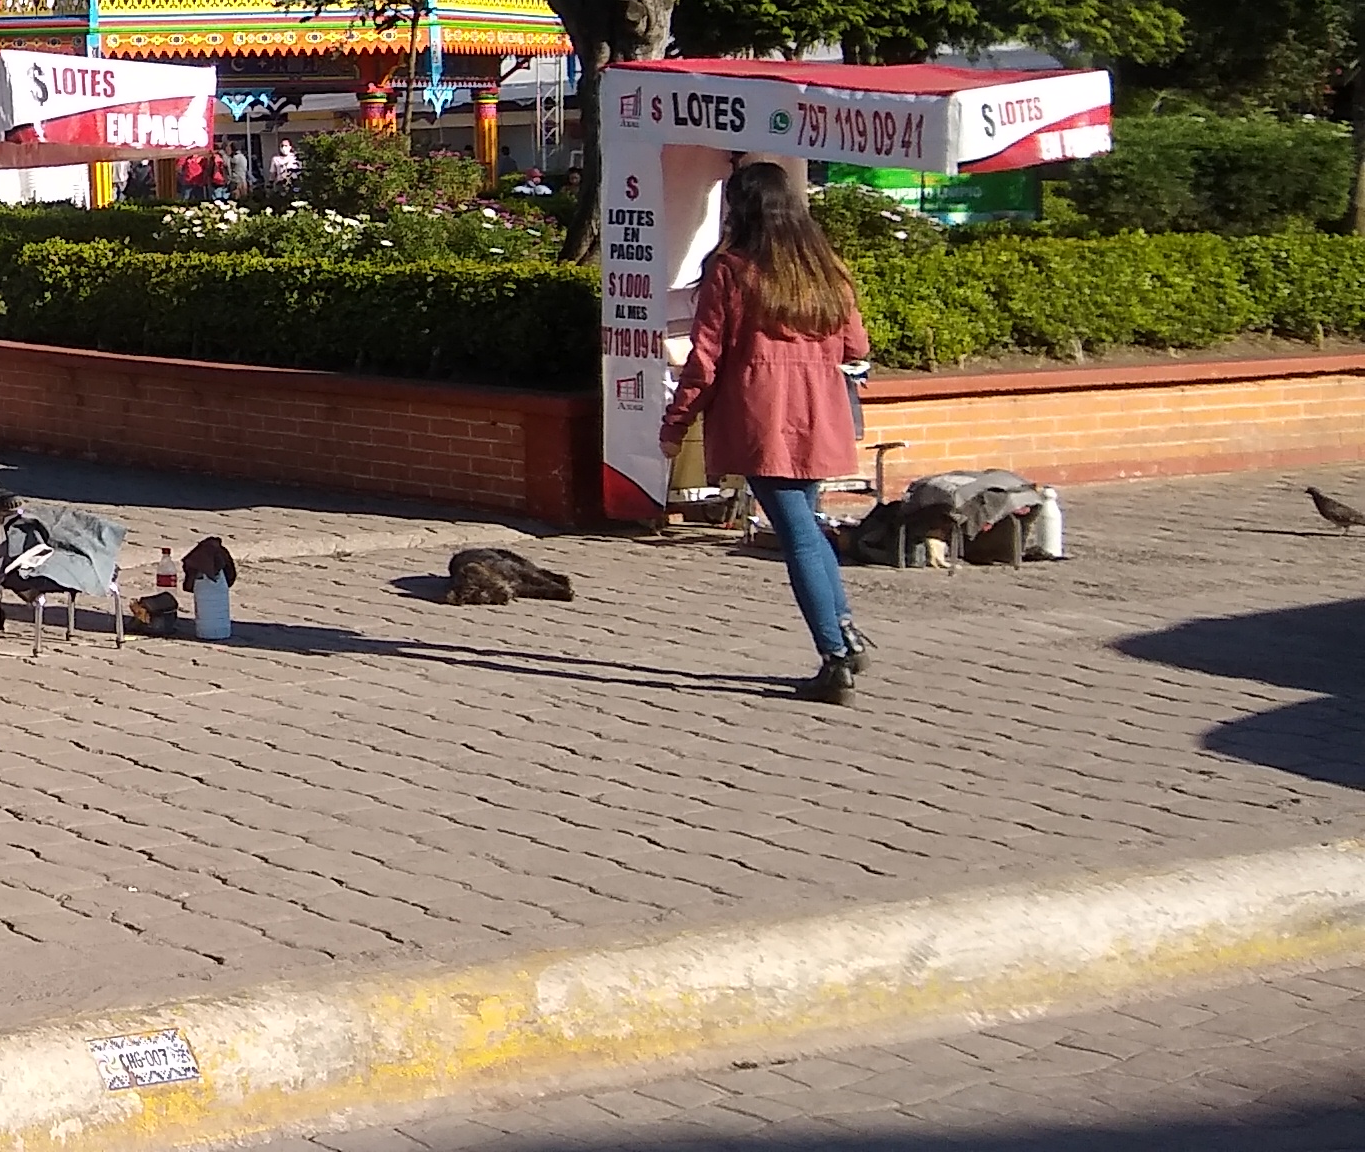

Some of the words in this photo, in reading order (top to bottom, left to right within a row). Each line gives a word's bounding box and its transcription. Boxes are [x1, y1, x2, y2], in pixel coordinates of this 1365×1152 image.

[27, 62, 49, 106] $
[52, 67, 116, 98] LOTES
[106, 112, 134, 144] EN
[137, 114, 209, 147] PAGOS
[651, 94, 663, 124] $
[671, 92, 746, 133] LOTES
[797, 102, 827, 148] 797
[835, 107, 868, 153] 119
[872, 110, 896, 156] 09
[901, 113, 924, 158] 41
[981, 102, 997, 139] $
[998, 97, 1043, 126] LOTES
[625, 175, 640, 201] $
[608, 209, 654, 227] LOTES
[623, 227, 640, 243] EN
[610, 243, 653, 262] PAGOS
[615, 304, 626, 319] AL
[627, 305, 648, 320] MES
[634, 328, 649, 359] 09
[651, 330, 663, 359] 41
